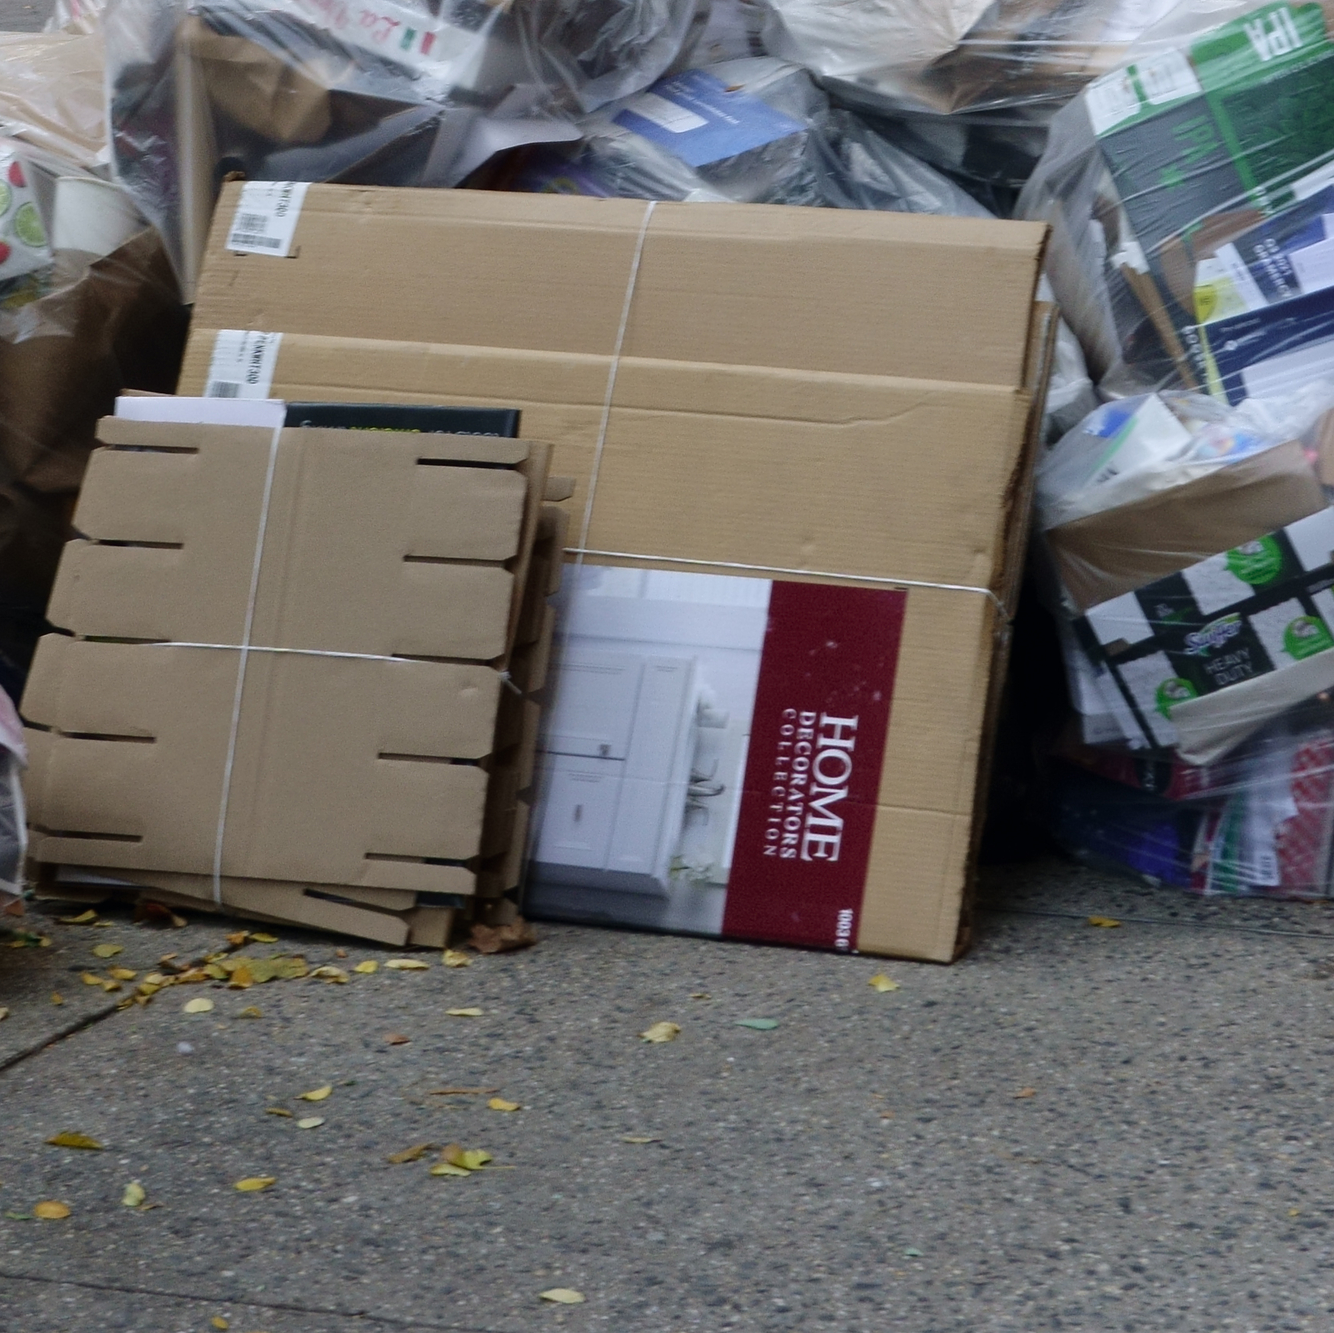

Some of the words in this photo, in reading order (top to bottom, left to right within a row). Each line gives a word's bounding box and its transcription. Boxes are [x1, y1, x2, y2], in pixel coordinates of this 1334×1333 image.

[1241, 6, 1304, 62] IPA
[1171, 115, 1220, 164] IPA
[1183, 618, 1243, 655] Swiffer
[1204, 647, 1251, 675] HEAVY
[1214, 661, 1254, 686] DUTY
[761, 706, 797, 858] COLLECTION
[778, 710, 815, 860] DECORATORS
[801, 713, 860, 864] HOME
